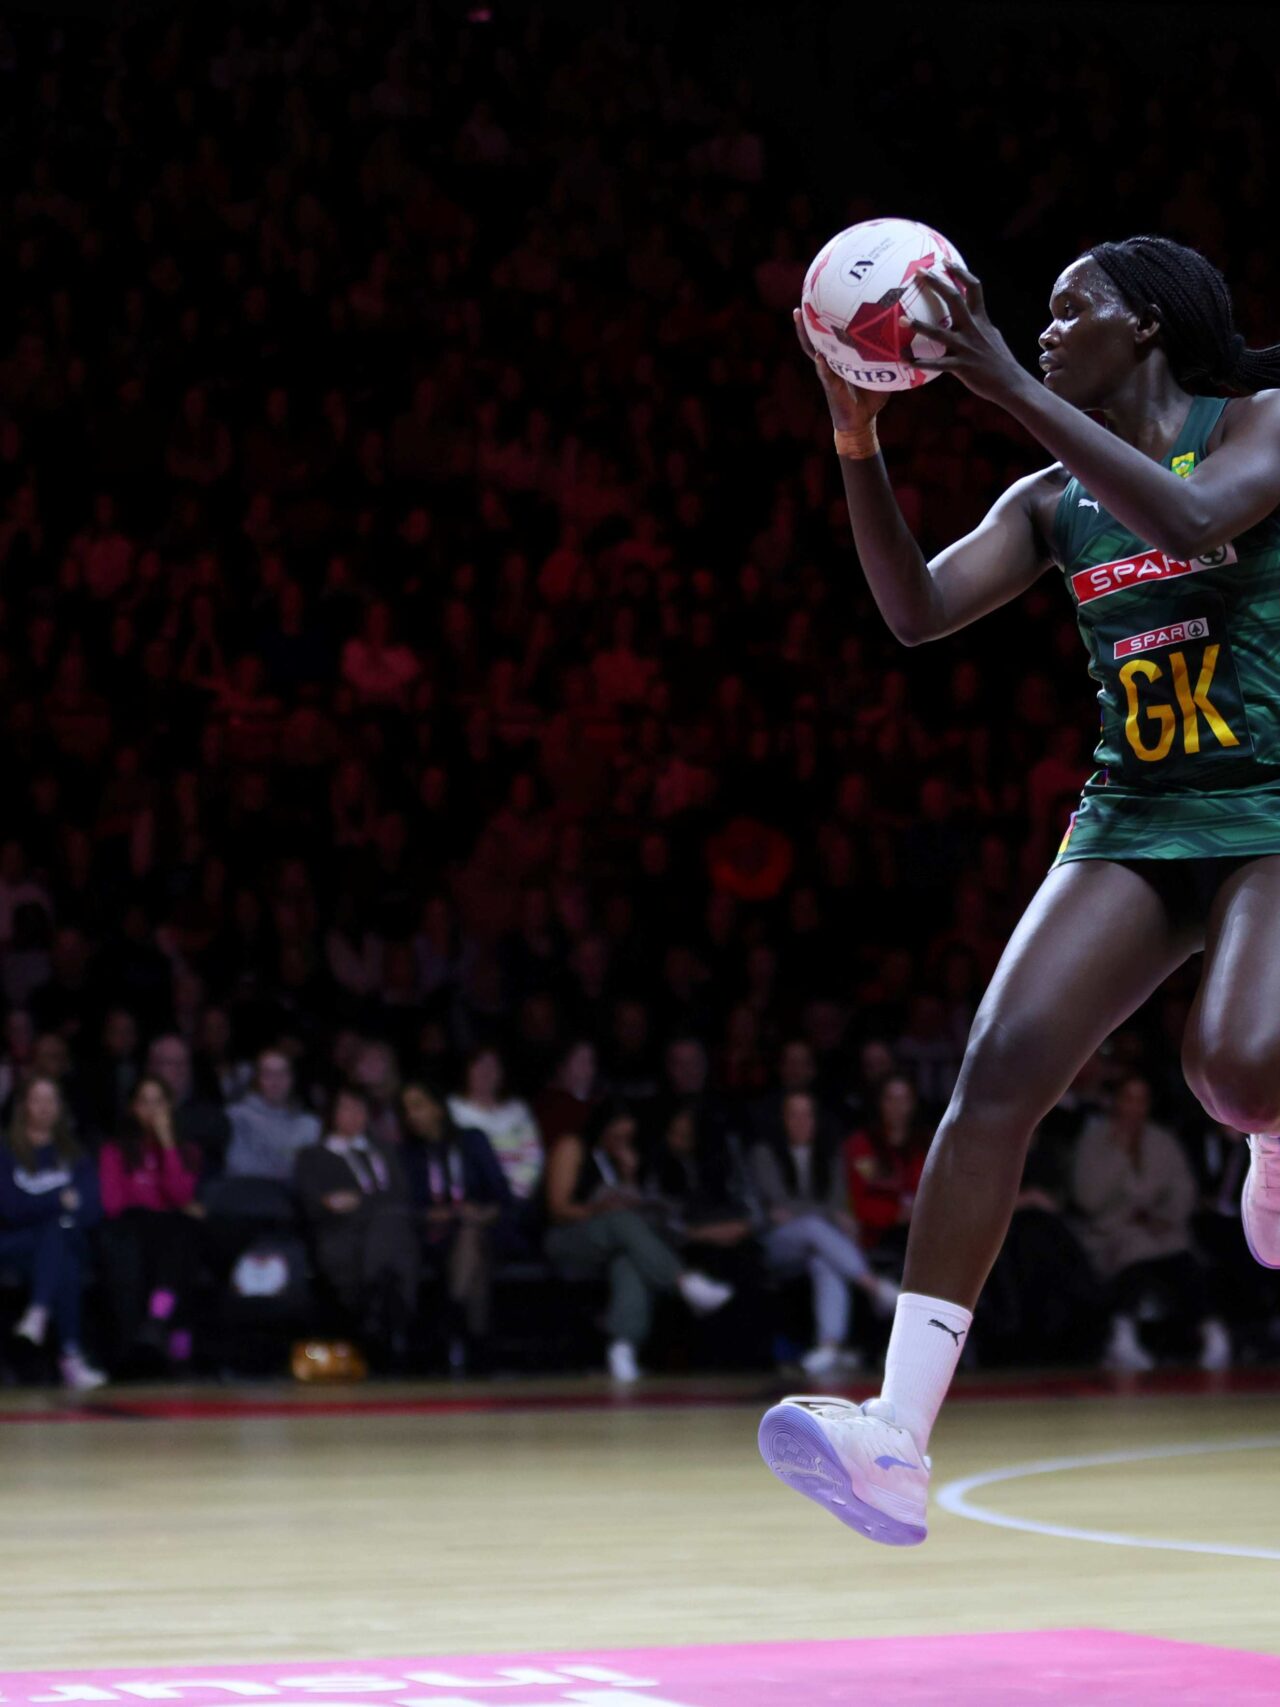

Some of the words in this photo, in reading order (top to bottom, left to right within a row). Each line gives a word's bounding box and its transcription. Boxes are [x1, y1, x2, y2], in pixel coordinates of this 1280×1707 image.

[1130, 627, 1184, 650] SPAR
[1118, 643, 1241, 762] GK
[0, 1665, 659, 1703] insur
